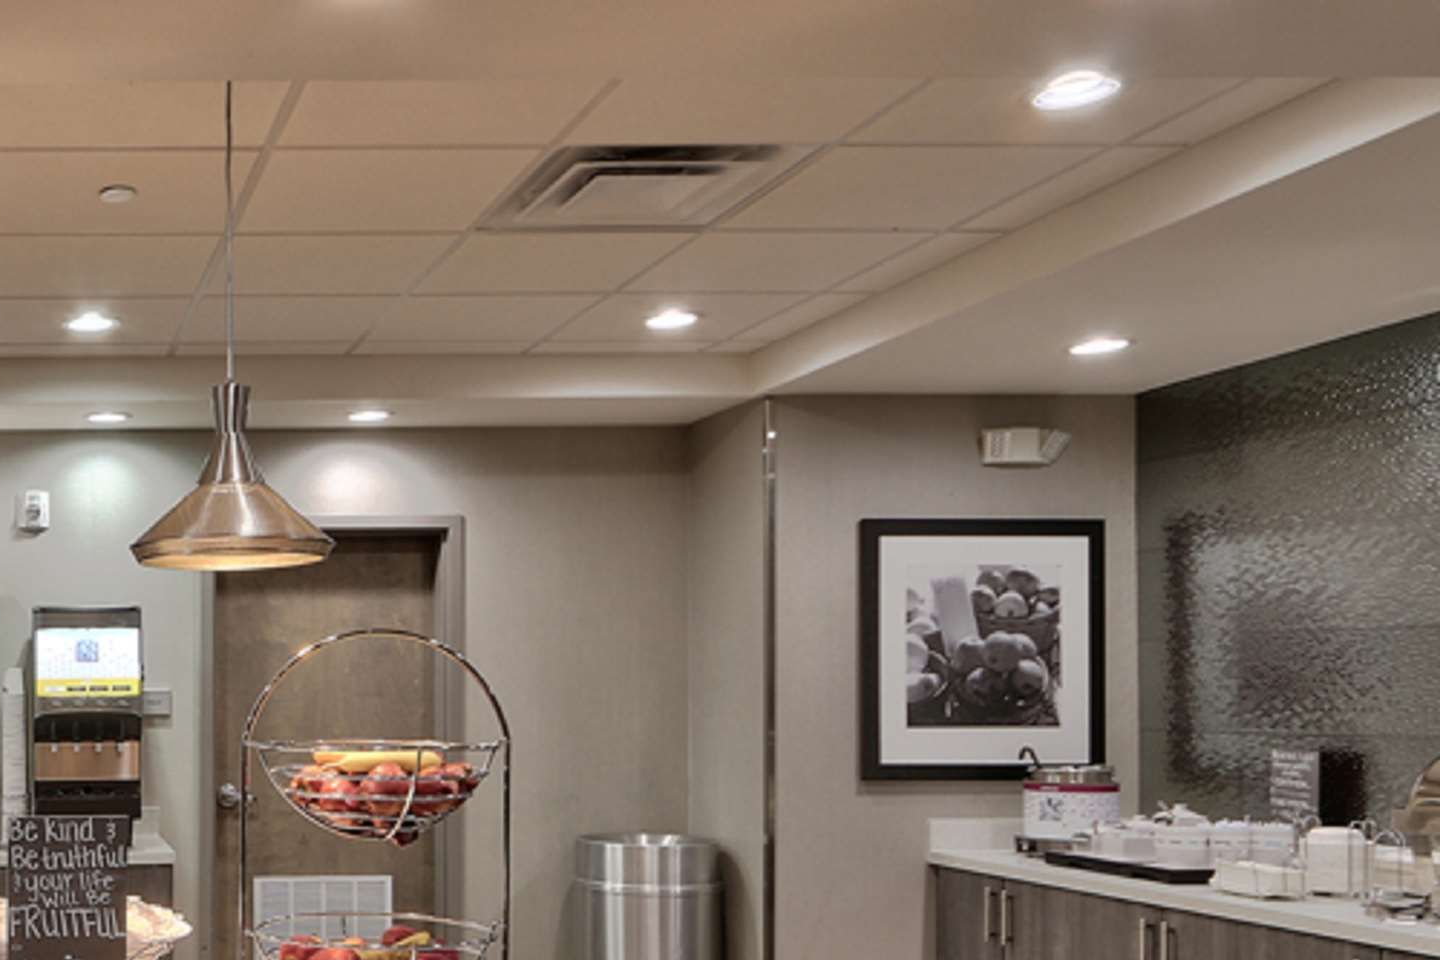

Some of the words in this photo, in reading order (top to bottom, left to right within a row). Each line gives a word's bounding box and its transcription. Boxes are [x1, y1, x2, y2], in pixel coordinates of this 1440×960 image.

[9, 817, 39, 842] Be
[10, 844, 39, 870] Be
[42, 842, 128, 870] truthful
[24, 872, 73, 902] your
[9, 902, 128, 939] FRUITFUL
